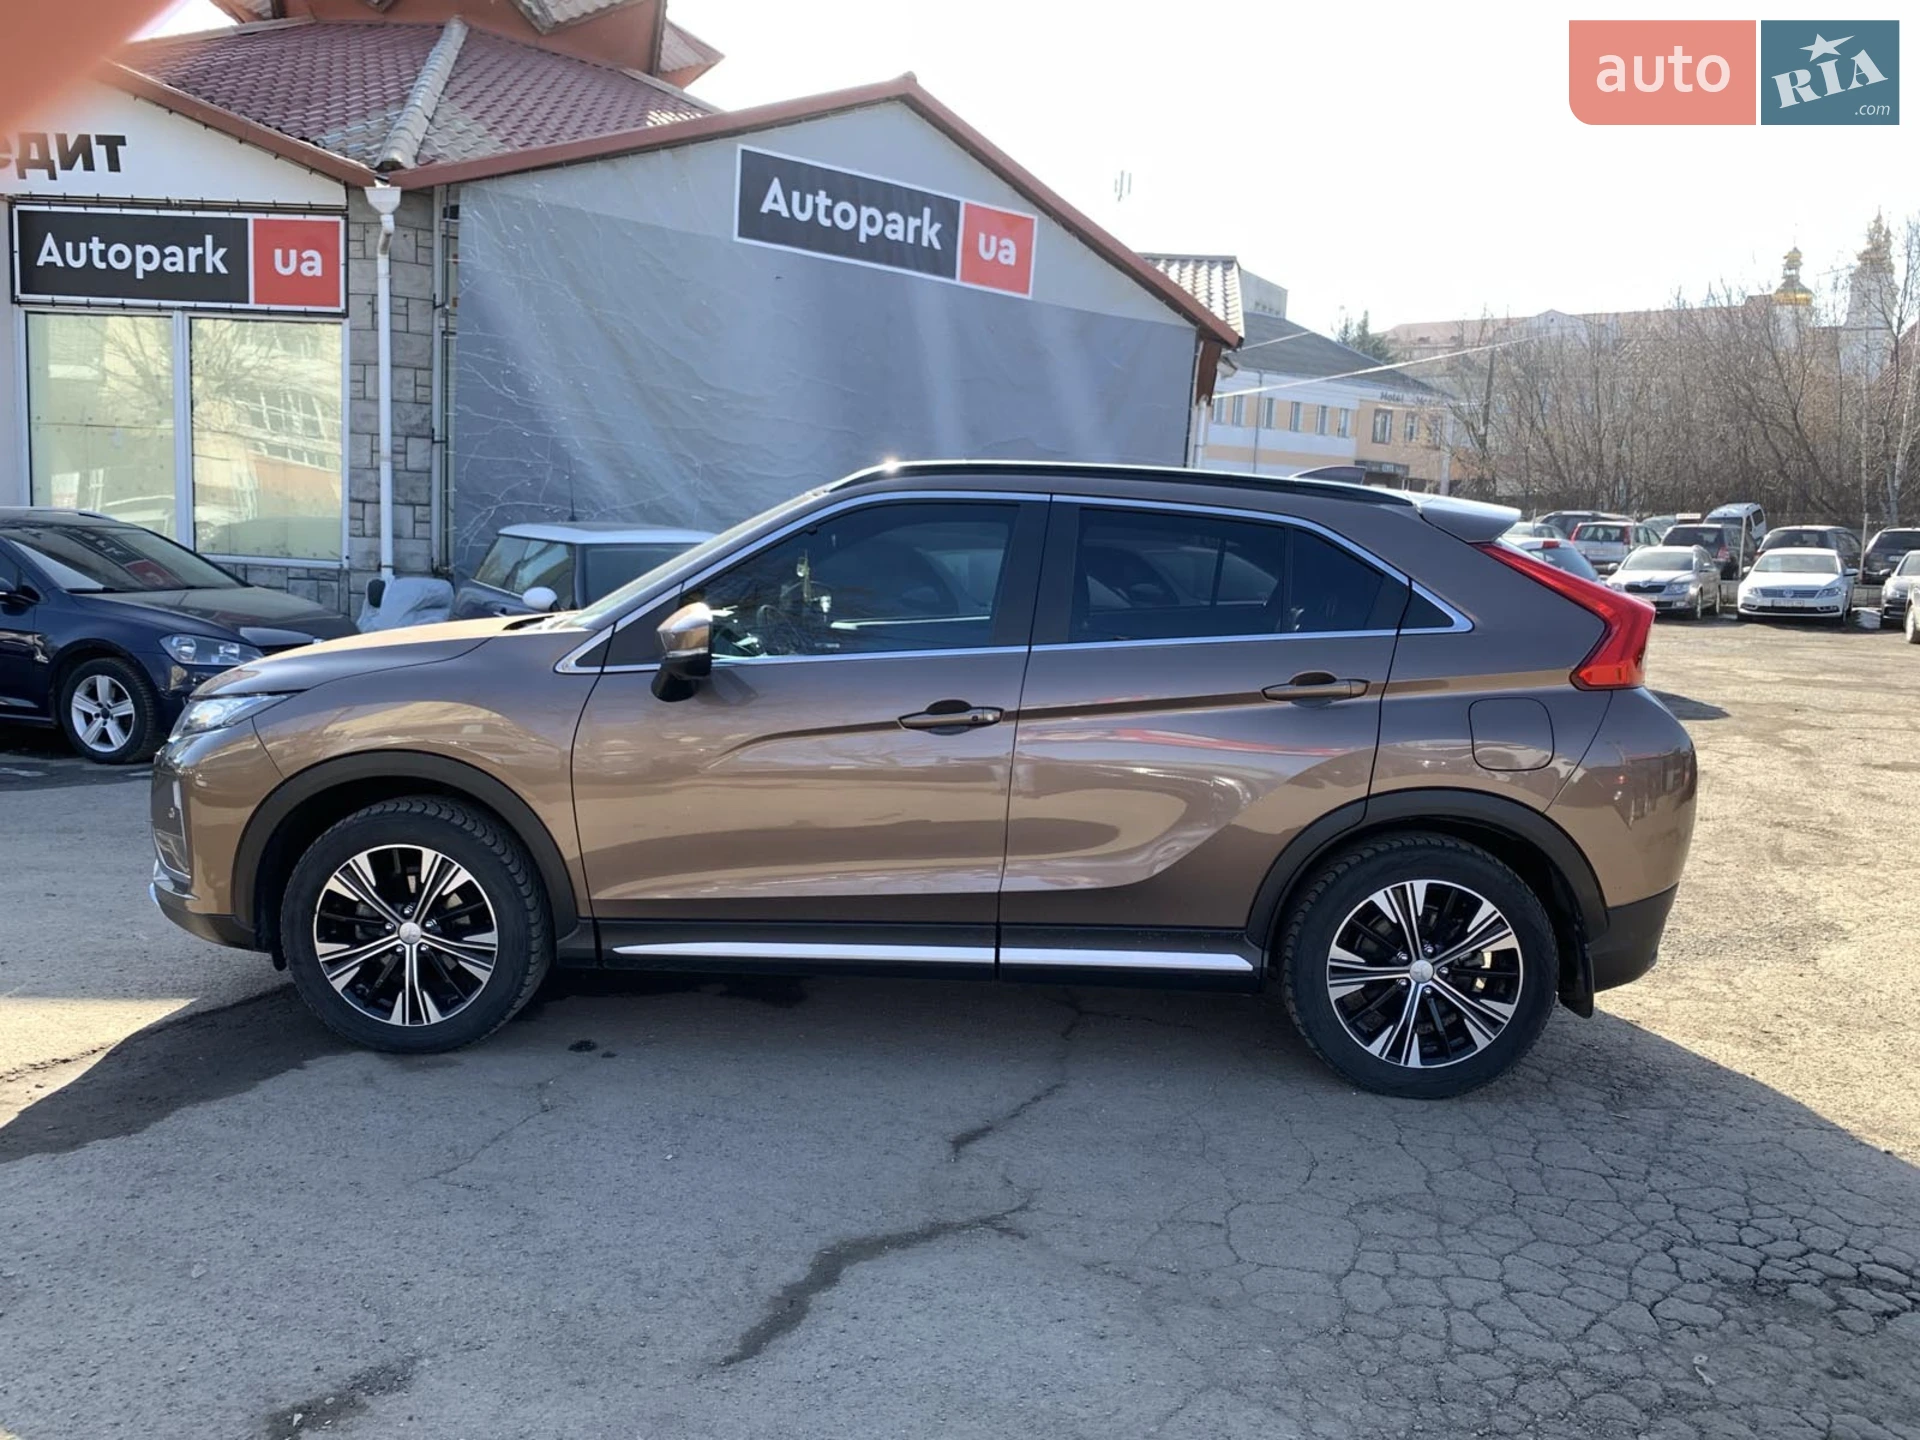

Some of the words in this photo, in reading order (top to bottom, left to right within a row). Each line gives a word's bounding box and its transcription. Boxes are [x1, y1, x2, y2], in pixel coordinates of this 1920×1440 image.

[36, 232, 229, 279] Autopark
[274, 248, 323, 277] ua
[760, 177, 942, 250] Autopark
[978, 232, 1017, 266] ua
